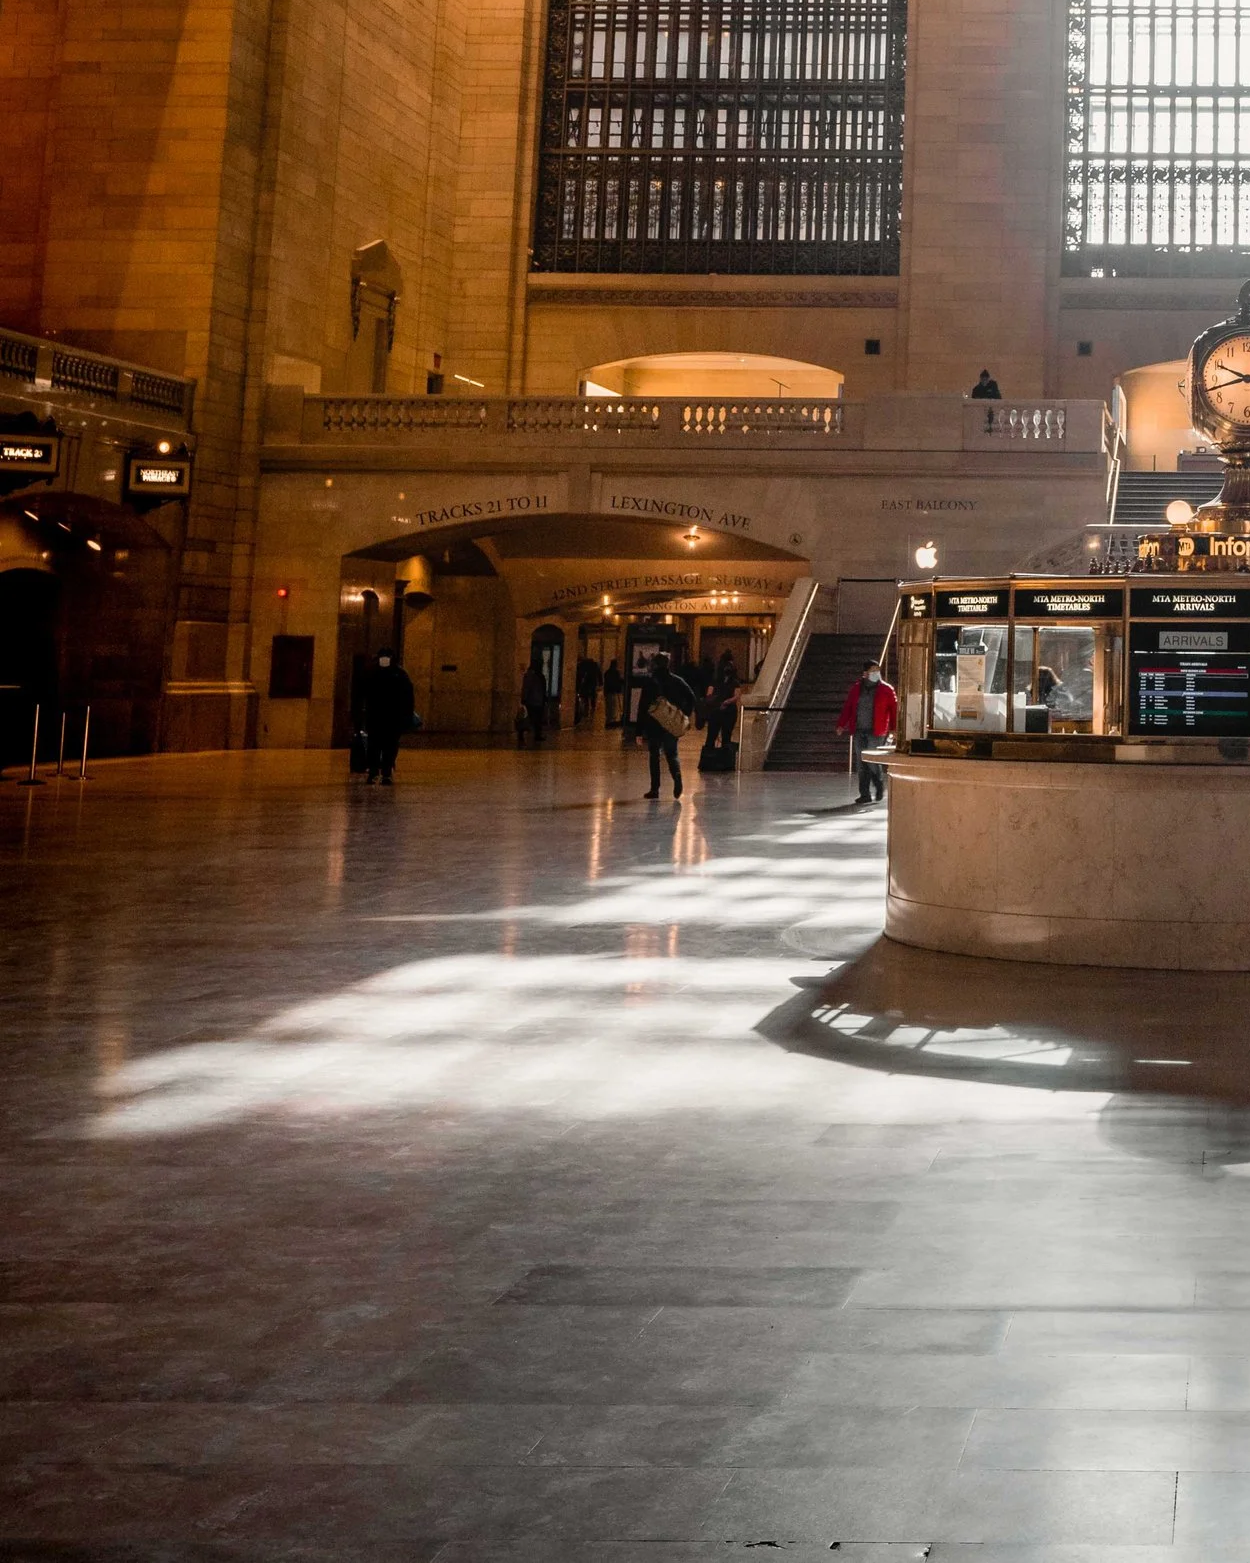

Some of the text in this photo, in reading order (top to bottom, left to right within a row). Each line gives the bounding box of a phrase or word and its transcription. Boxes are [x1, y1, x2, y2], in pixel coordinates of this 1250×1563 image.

[1226, 346, 1235, 358] 11
[1214, 358, 1223, 370] 10
[1211, 374, 1218, 386] 9
[1216, 391, 1223, 404] 8
[1227, 402, 1235, 414] 7
[1243, 405, 1250, 418] 6
[3, 447, 33, 458] TRACK
[416, 503, 483, 526] TRACKS
[487, 500, 503, 515] 21
[506, 496, 533, 512] TO
[881, 500, 977, 511] EAST BALCONY
[610, 495, 750, 529] LEXINGTON AVE
[552, 584, 588, 600] 42ND
[591, 577, 639, 592] STREET
[644, 574, 702, 587] PASSAGE
[716, 575, 769, 590] SUBWAY
[960, 596, 998, 604] METRO-NORTH
[1050, 595, 1105, 603] METRO-NORTH
[1152, 595, 1236, 603] MTA METRO-NORTH
[645, 601, 696, 610] XINGTON
[958, 604, 988, 612] TIMETABLES
[1047, 603, 1091, 611] TIMETABLES
[1174, 603, 1215, 611] ARRIVALS
[1163, 636, 1224, 647] ARRIVALS
